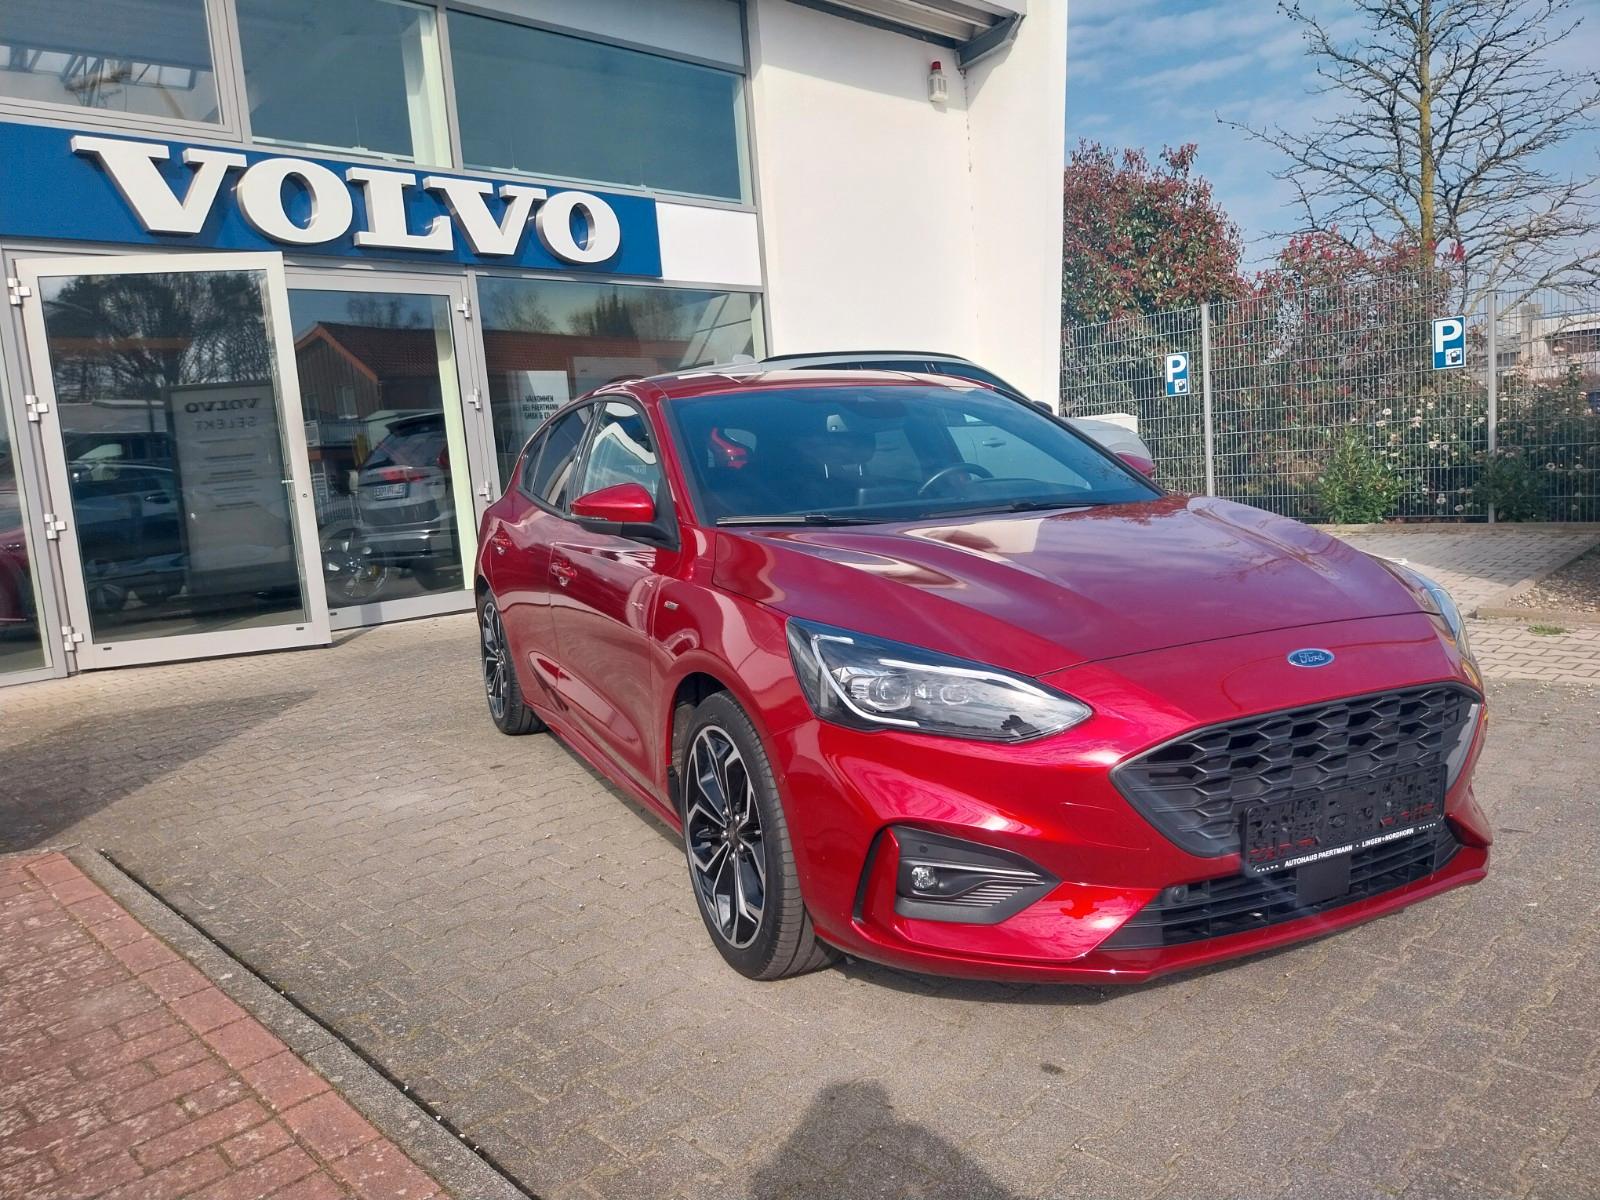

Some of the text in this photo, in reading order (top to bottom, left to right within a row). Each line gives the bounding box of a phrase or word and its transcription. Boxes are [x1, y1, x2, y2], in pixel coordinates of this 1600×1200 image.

[70, 135, 621, 264] VOLVO
[1435, 319, 1462, 353] P
[1166, 355, 1187, 383] P
[1298, 651, 1325, 664] Ford
[1284, 853, 1318, 868] AUTOHAUS
[1318, 844, 1353, 859] PAERTMANN
